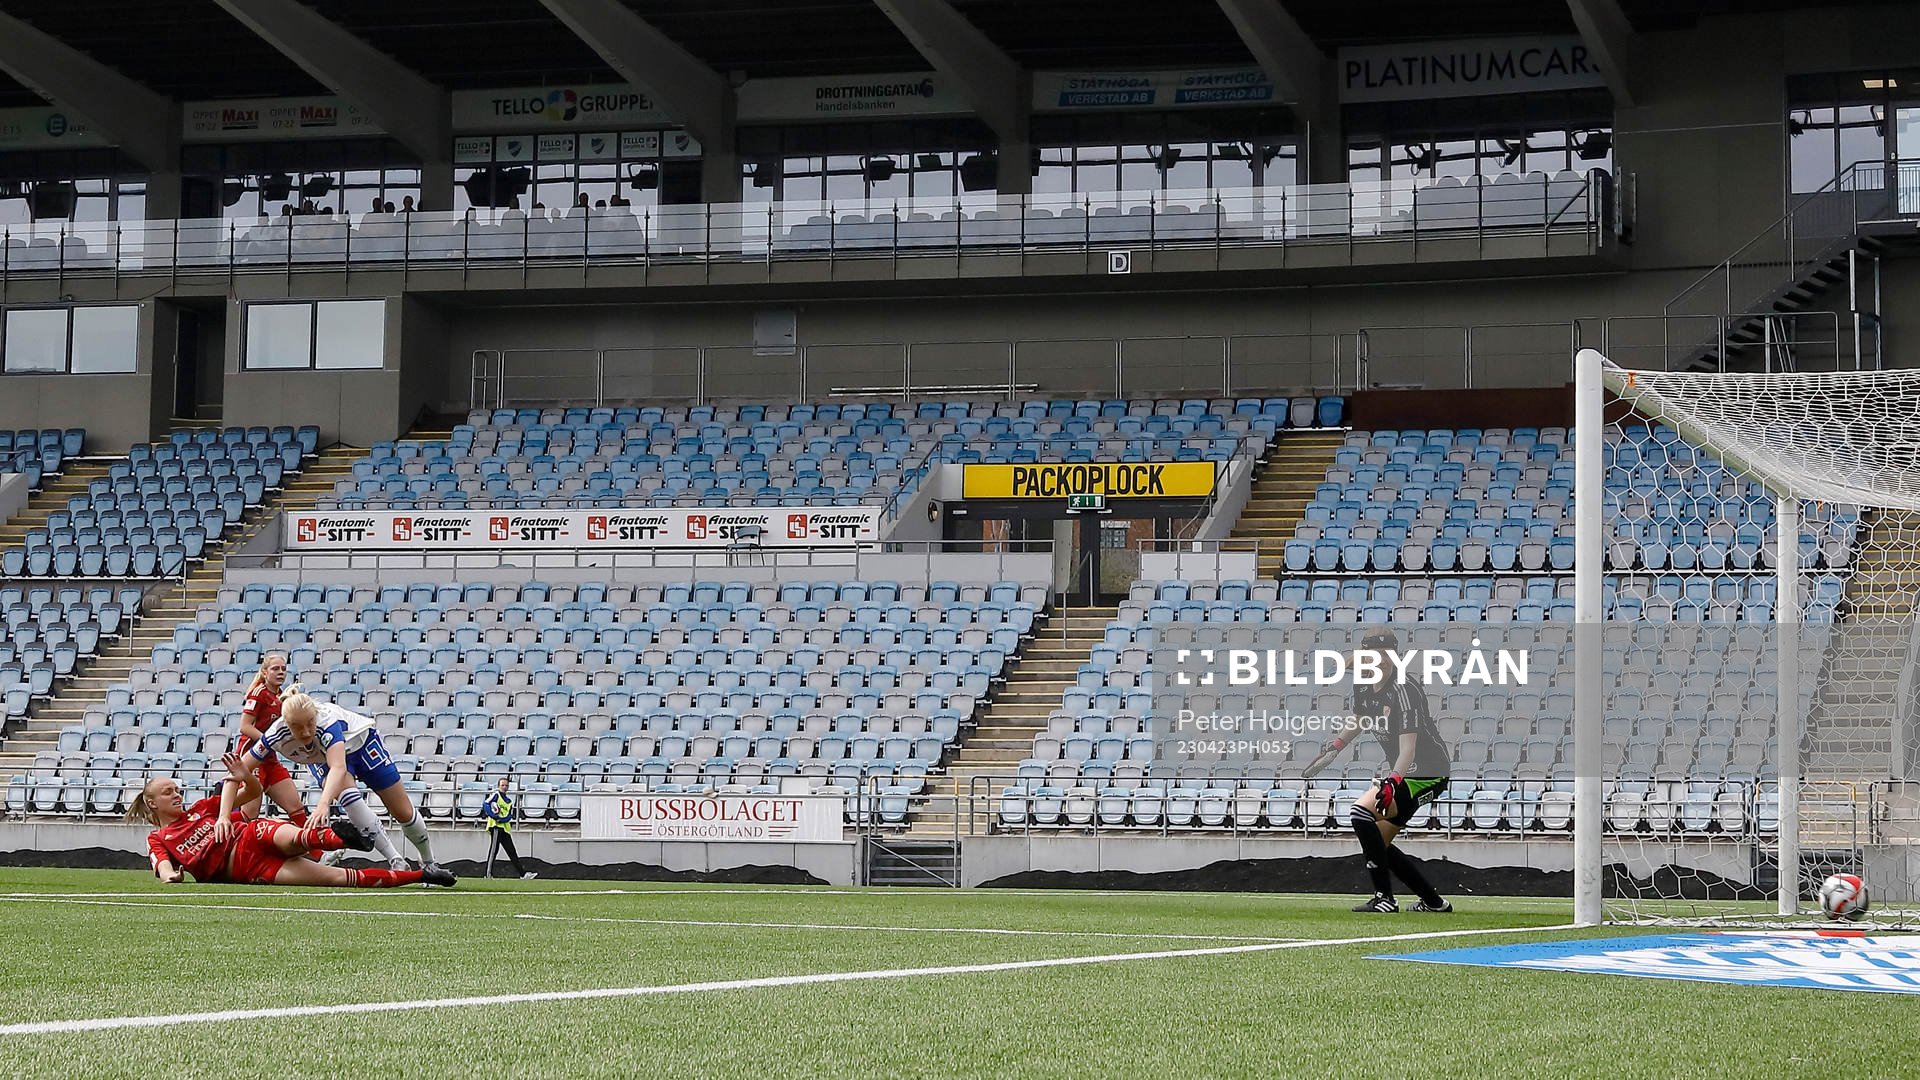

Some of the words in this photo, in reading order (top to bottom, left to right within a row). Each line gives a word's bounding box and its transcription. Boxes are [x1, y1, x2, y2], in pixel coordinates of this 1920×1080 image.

[1068, 94, 1129, 105] VERKSTAD
[1132, 92, 1149, 103] AB
[300, 106, 338, 120] MAXI
[493, 98, 545, 115] TELLO
[815, 101, 897, 112] Handelsbanken
[222, 109, 259, 122] MAXI
[1111, 253, 1127, 272] D
[1012, 465, 1165, 496] PACKOPLOCK
[318, 517, 375, 528] Anatomic
[414, 517, 471, 528] Anatomic
[511, 516, 569, 527] Anatomic
[609, 515, 669, 526] Anatomic
[709, 515, 769, 525] Anatomic
[809, 514, 871, 524] Anatomic
[619, 799, 803, 822] BUSSBOLAGET
[657, 824, 763, 838] ÖSTERGÖTLAND
[176, 821, 214, 855] Prioritet
